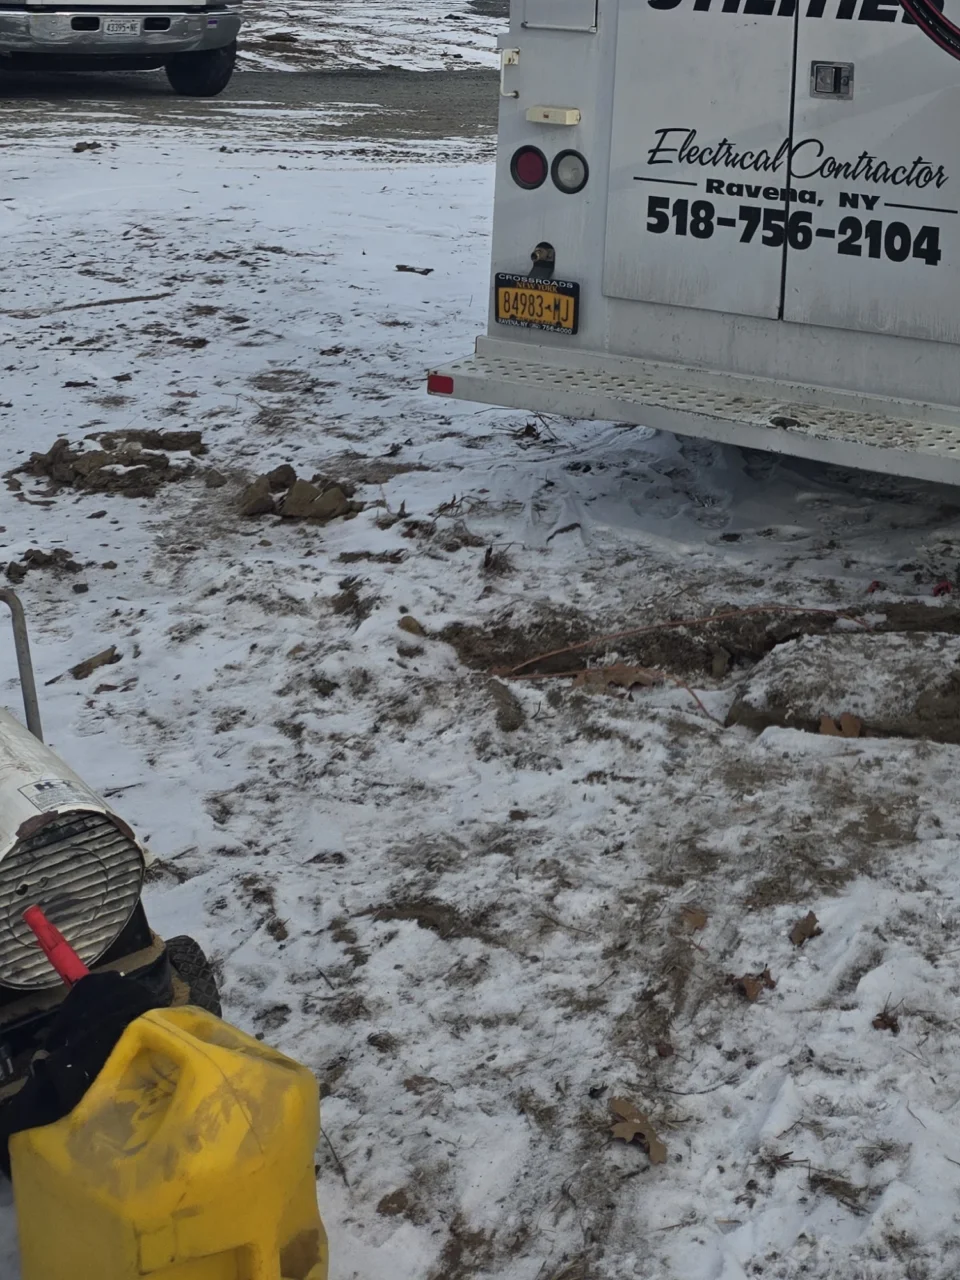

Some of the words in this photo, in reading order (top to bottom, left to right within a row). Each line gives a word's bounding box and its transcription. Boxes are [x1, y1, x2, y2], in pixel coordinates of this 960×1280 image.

[647, 128, 790, 172] Electrical
[788, 138, 949, 189] Contractor
[705, 178, 824, 207] Ravena,
[839, 192, 880, 211] NY
[646, 195, 941, 266] 518-756-2104
[498, 273, 573, 289] CROSSROADS
[537, 284, 558, 293] YORK
